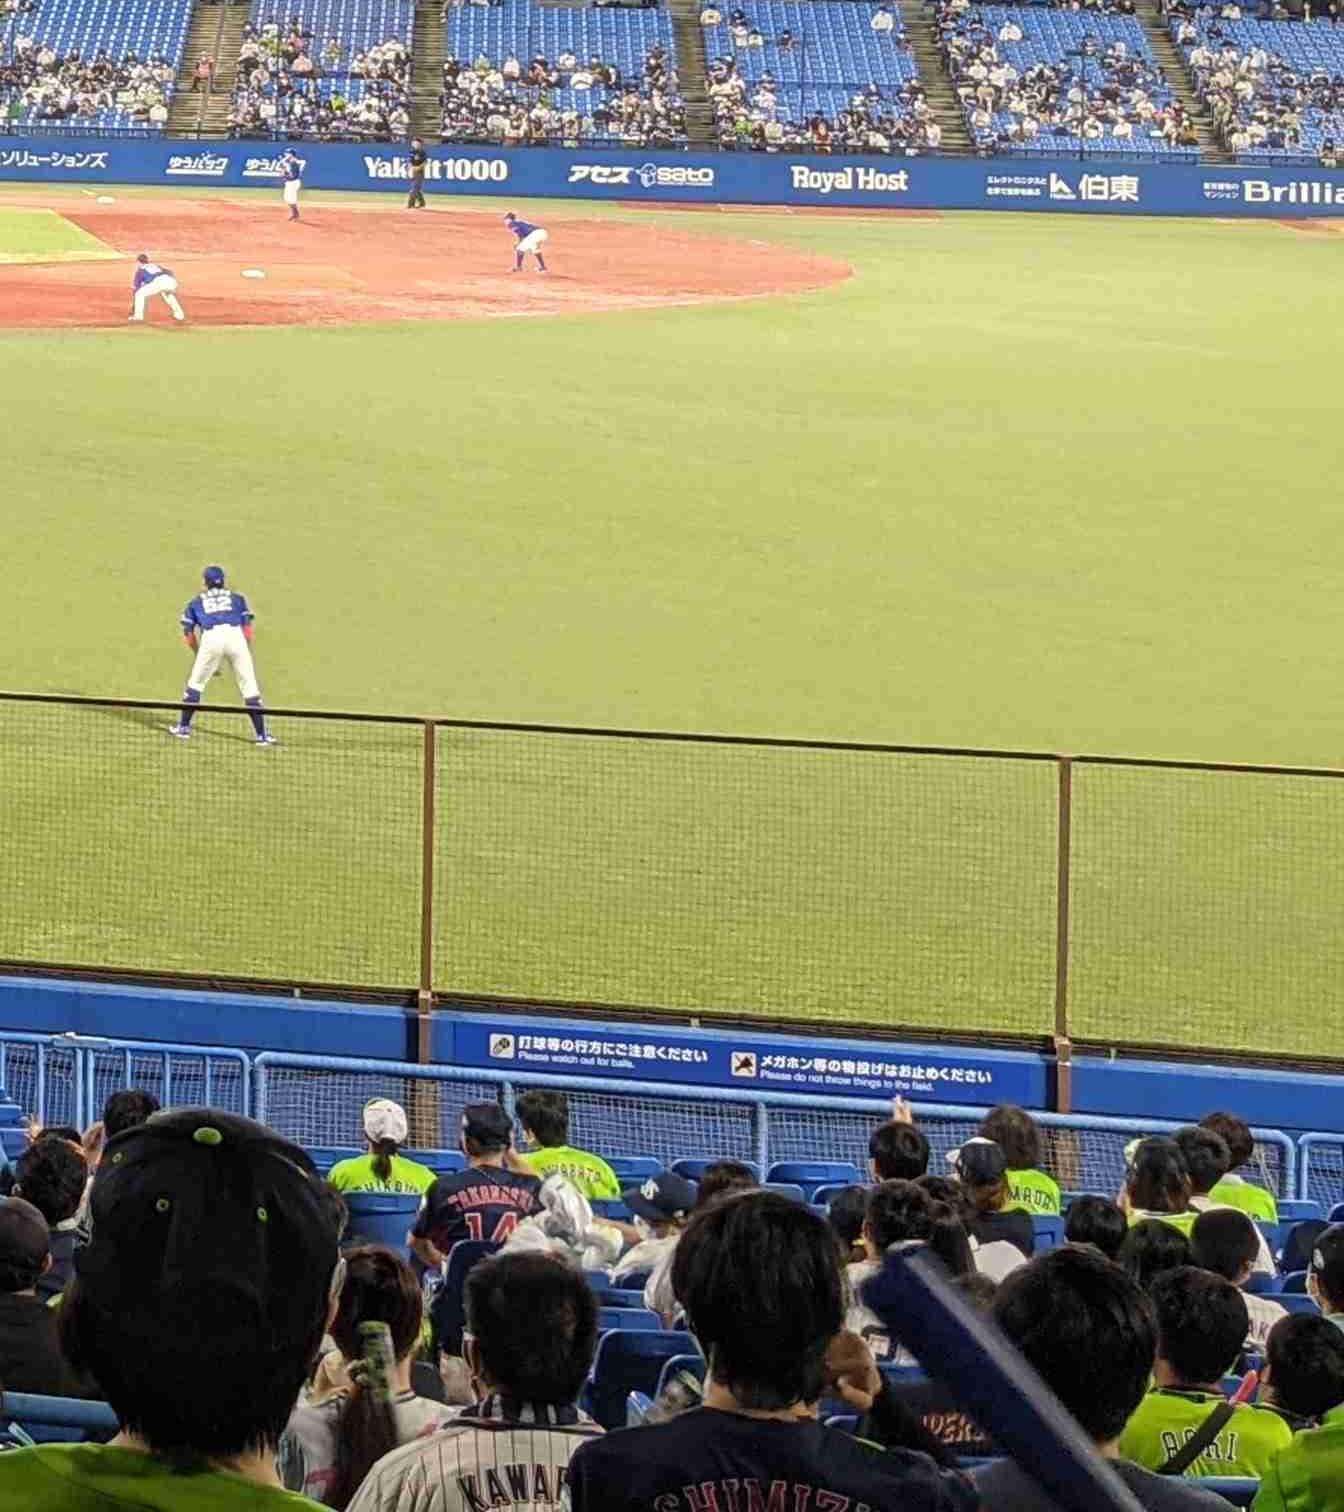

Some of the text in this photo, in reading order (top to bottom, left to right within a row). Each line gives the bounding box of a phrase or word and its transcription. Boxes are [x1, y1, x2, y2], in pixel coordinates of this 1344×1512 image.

[568, 165, 634, 184] アセス
[791, 166, 909, 193] Royal Host
[1079, 173, 1140, 202] 伯東
[518, 1035, 709, 1063] 打球等の行方にご注意ください
[518, 1050, 549, 1062] Please
[552, 1053, 579, 1064] watch
[580, 1055, 596, 1066] out
[597, 1056, 610, 1066] for
[760, 1068, 792, 1081] Please
[793, 1071, 806, 1082] do
[809, 1072, 824, 1084] not
[825, 1074, 852, 1085] throw
[853, 1075, 882, 1089] things
[883, 1078, 894, 1088] to
[895, 1078, 910, 1090] the
[761, 1055, 993, 1084] メガホン等の物投げはお止めください
[465, 1212, 518, 1242] 14
